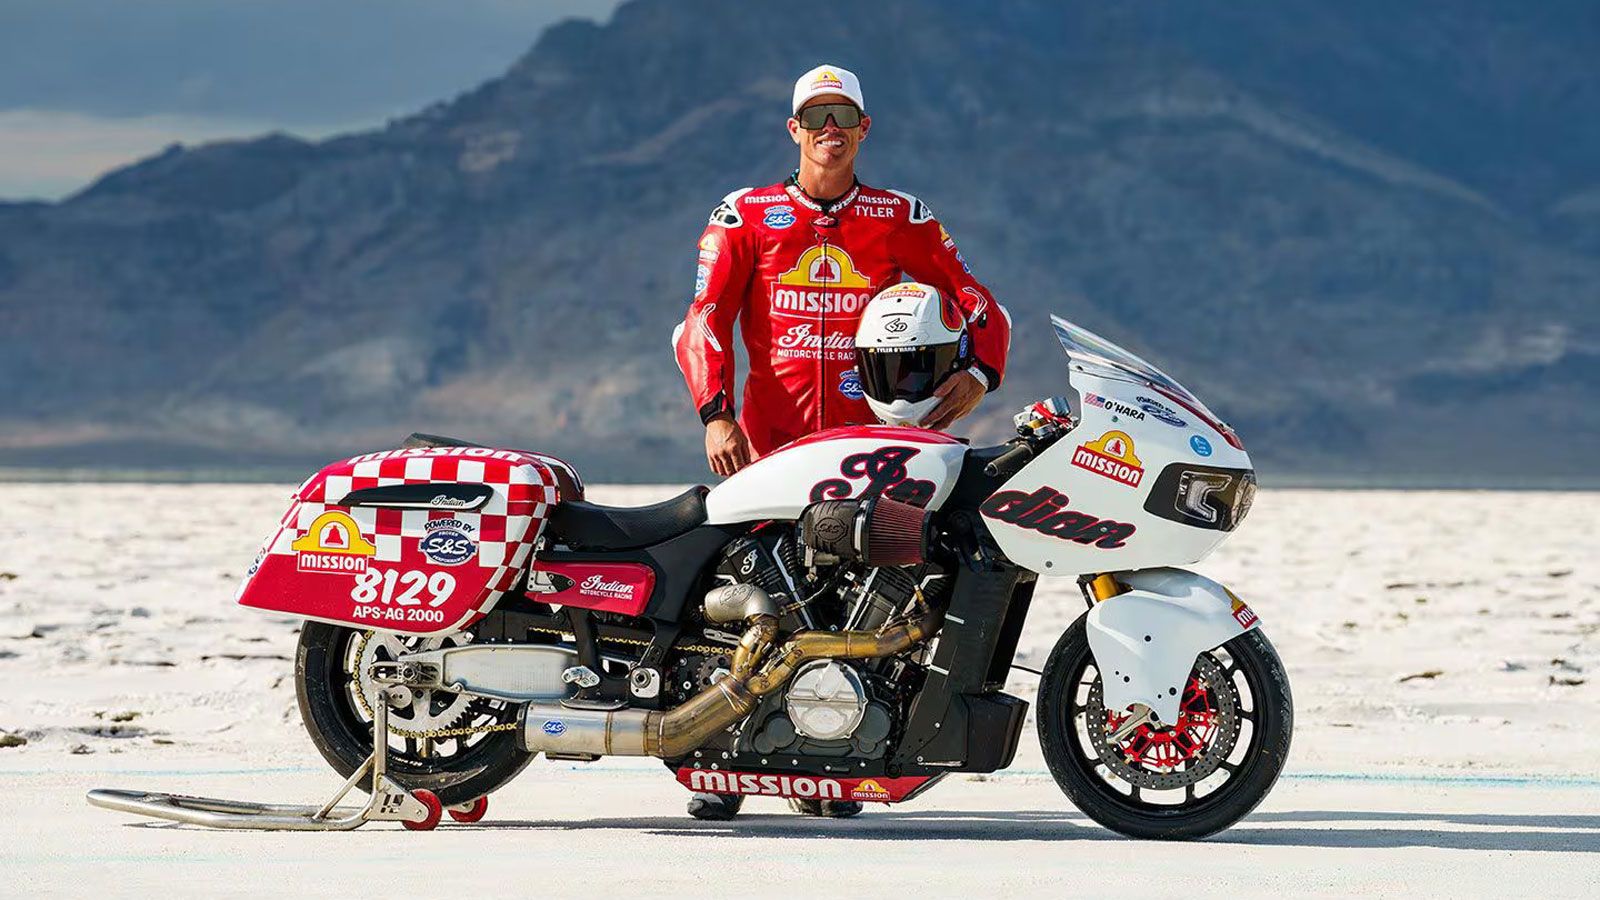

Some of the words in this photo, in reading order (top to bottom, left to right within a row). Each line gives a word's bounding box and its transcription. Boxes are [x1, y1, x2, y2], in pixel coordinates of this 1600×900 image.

[768, 214, 792, 223] S&S
[854, 205, 894, 217] TYLER
[778, 323, 857, 349] India
[1104, 401, 1146, 421] O'HARA
[431, 495, 465, 507] Indian
[424, 519, 462, 531] POWERED
[463, 523, 475, 533] BY
[427, 538, 469, 555] S&S
[351, 567, 456, 607] 8129
[580, 575, 634, 593] Indian
[580, 589, 613, 598] MOTORCYCLE
[614, 592, 633, 600] RACING
[352, 605, 404, 620] APS-AG
[407, 609, 444, 622] 2000
